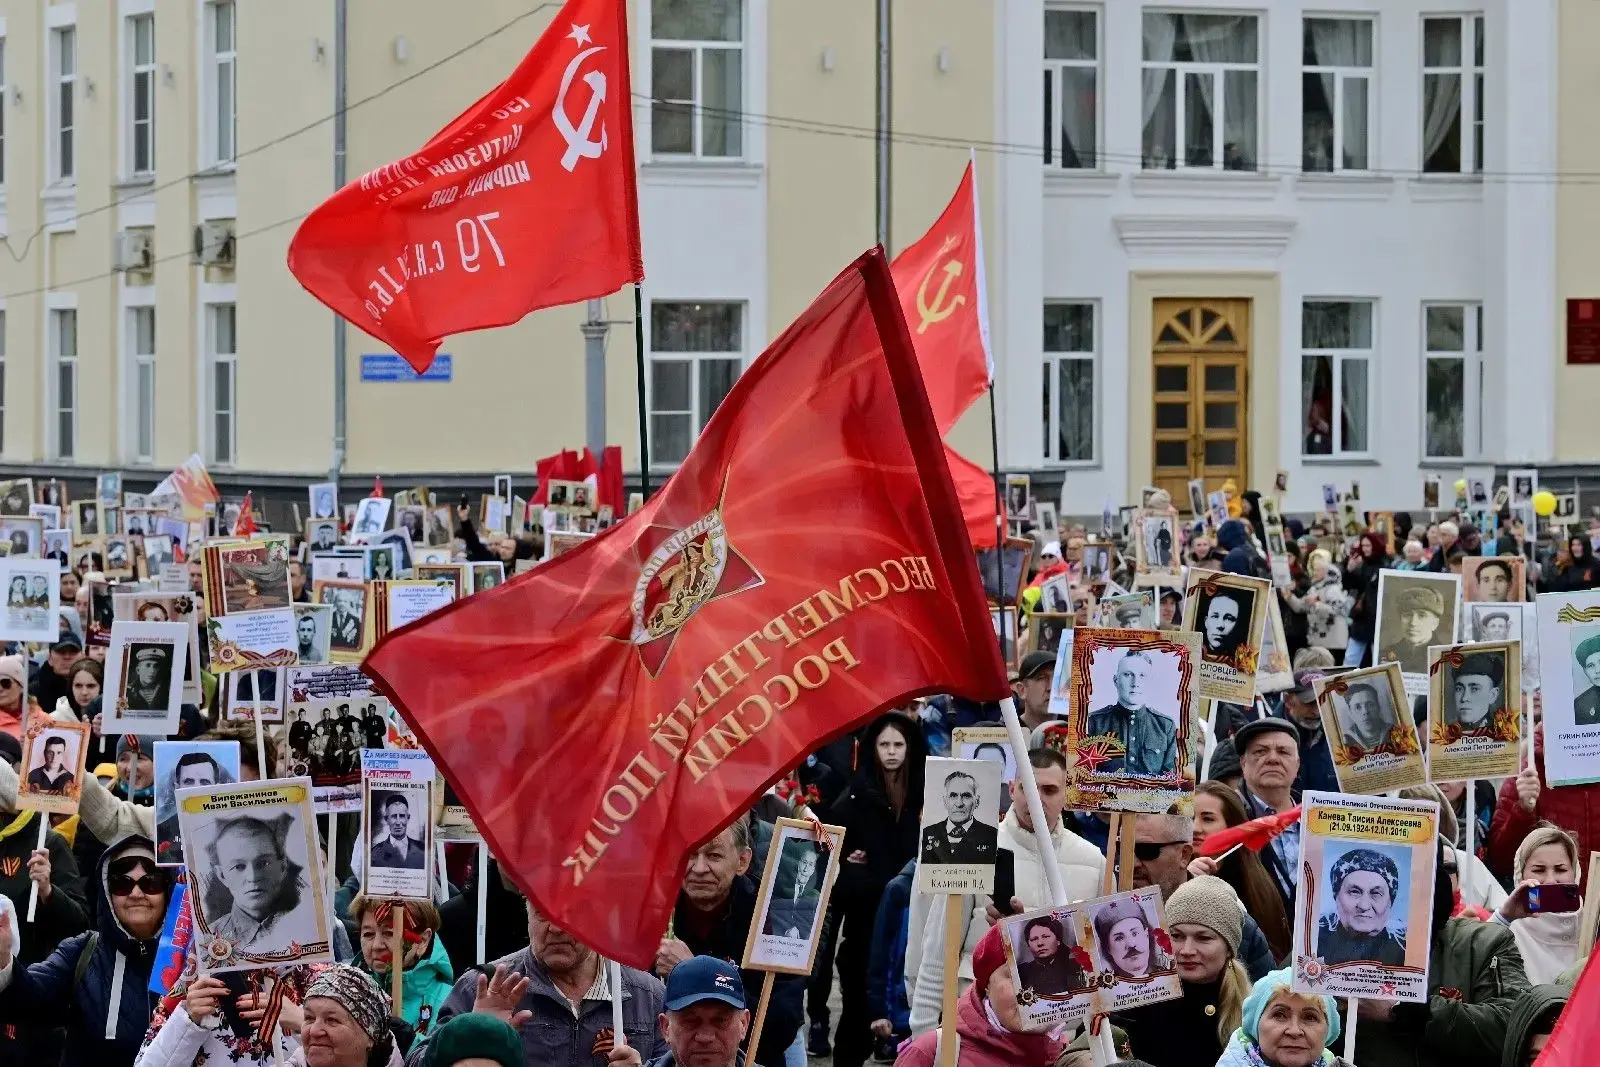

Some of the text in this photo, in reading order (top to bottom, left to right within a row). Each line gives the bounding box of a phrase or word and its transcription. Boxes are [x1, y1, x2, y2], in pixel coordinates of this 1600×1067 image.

[1199, 663, 1237, 676] ОПОВЦЕВ
[1461, 736, 1488, 745] Попов
[1473, 743, 1506, 751] Петрович
[1364, 752, 1390, 763] Попов
[231, 796, 288, 808] Васильевич
[1311, 796, 1437, 815] Участник Великой Отечественной войны
[1318, 810, 1423, 829] Канева Таисия Алексеевна
